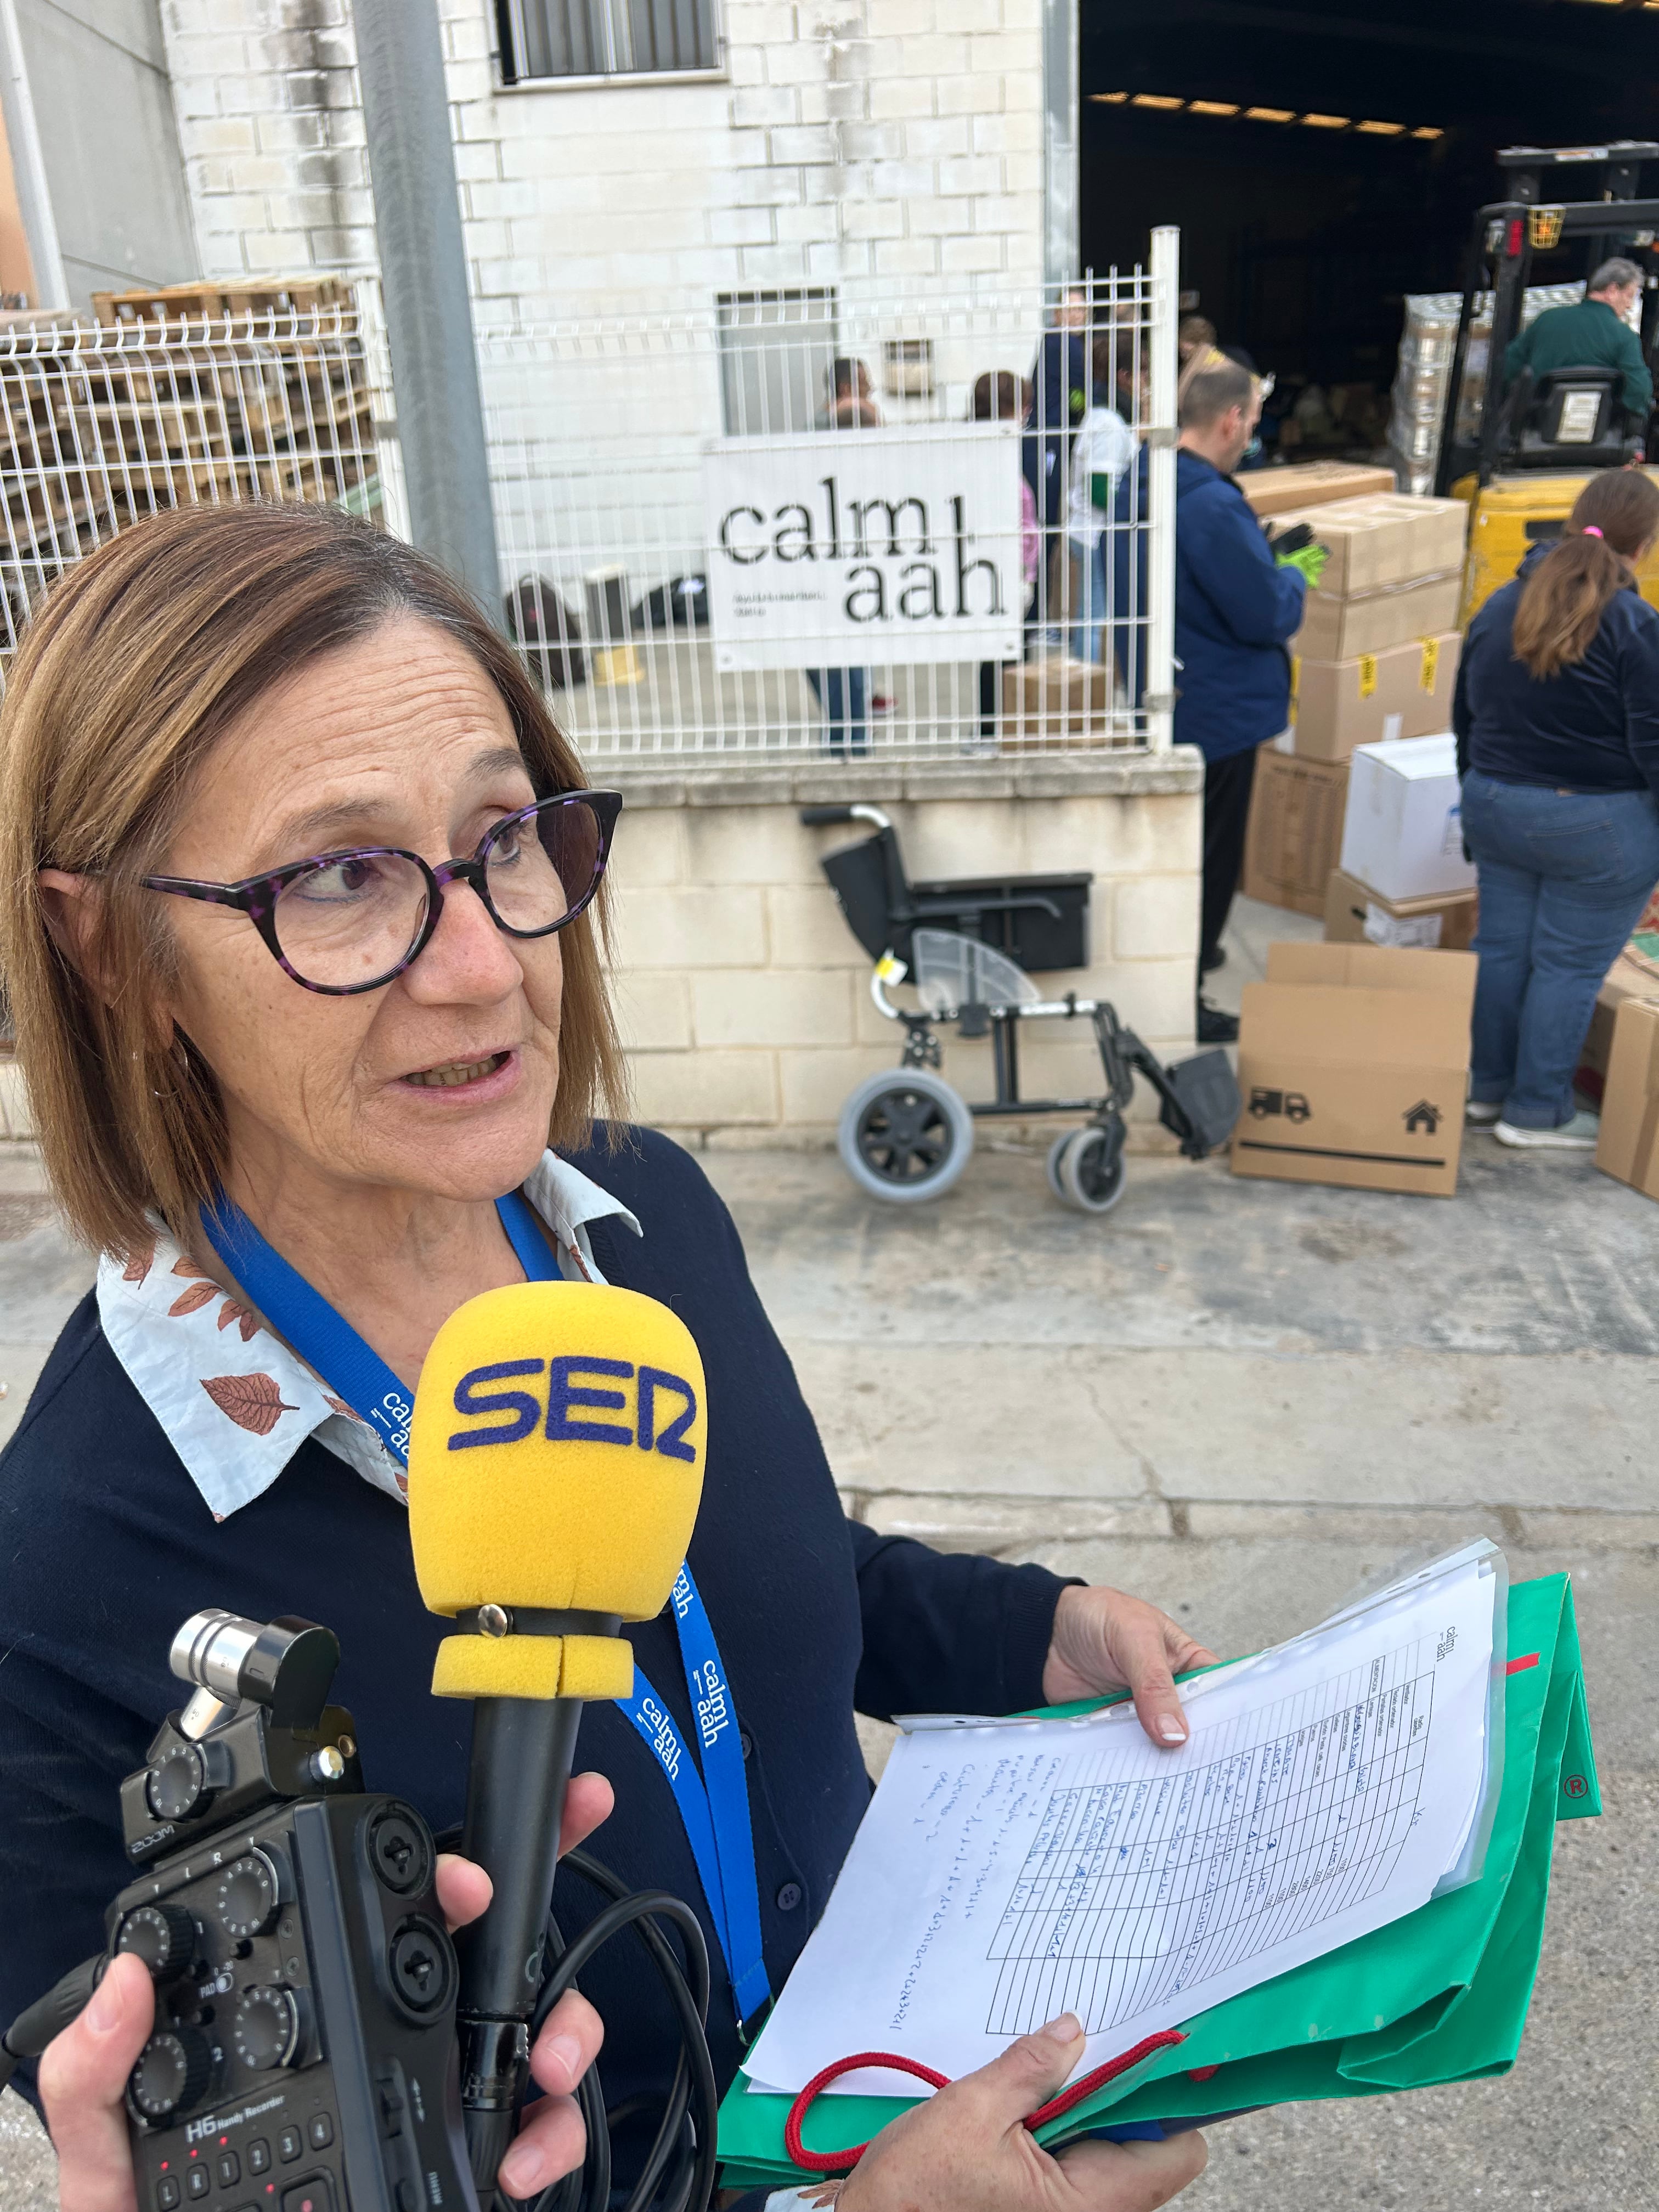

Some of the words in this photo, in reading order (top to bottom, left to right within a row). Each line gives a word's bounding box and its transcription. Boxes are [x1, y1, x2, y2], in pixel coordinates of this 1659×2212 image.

[720, 476, 938, 565] calm
[844, 495, 1008, 623] aah
[447, 1355, 697, 1464] SER
[1436, 1642, 1454, 1662] aah
[1446, 1626, 1459, 1651] calm
[703, 1660, 726, 1722] calm
[643, 1698, 677, 1754] calm
[697, 1700, 729, 1748] aah
[654, 1735, 681, 1780] aah
[213, 1852, 223, 1865] R
[200, 1982, 216, 1999] PAD
[185, 2114, 218, 2143] H6
[217, 2111, 245, 2130] Handy
[244, 2094, 286, 2118] Recorder
[315, 2123, 325, 2139] 4
